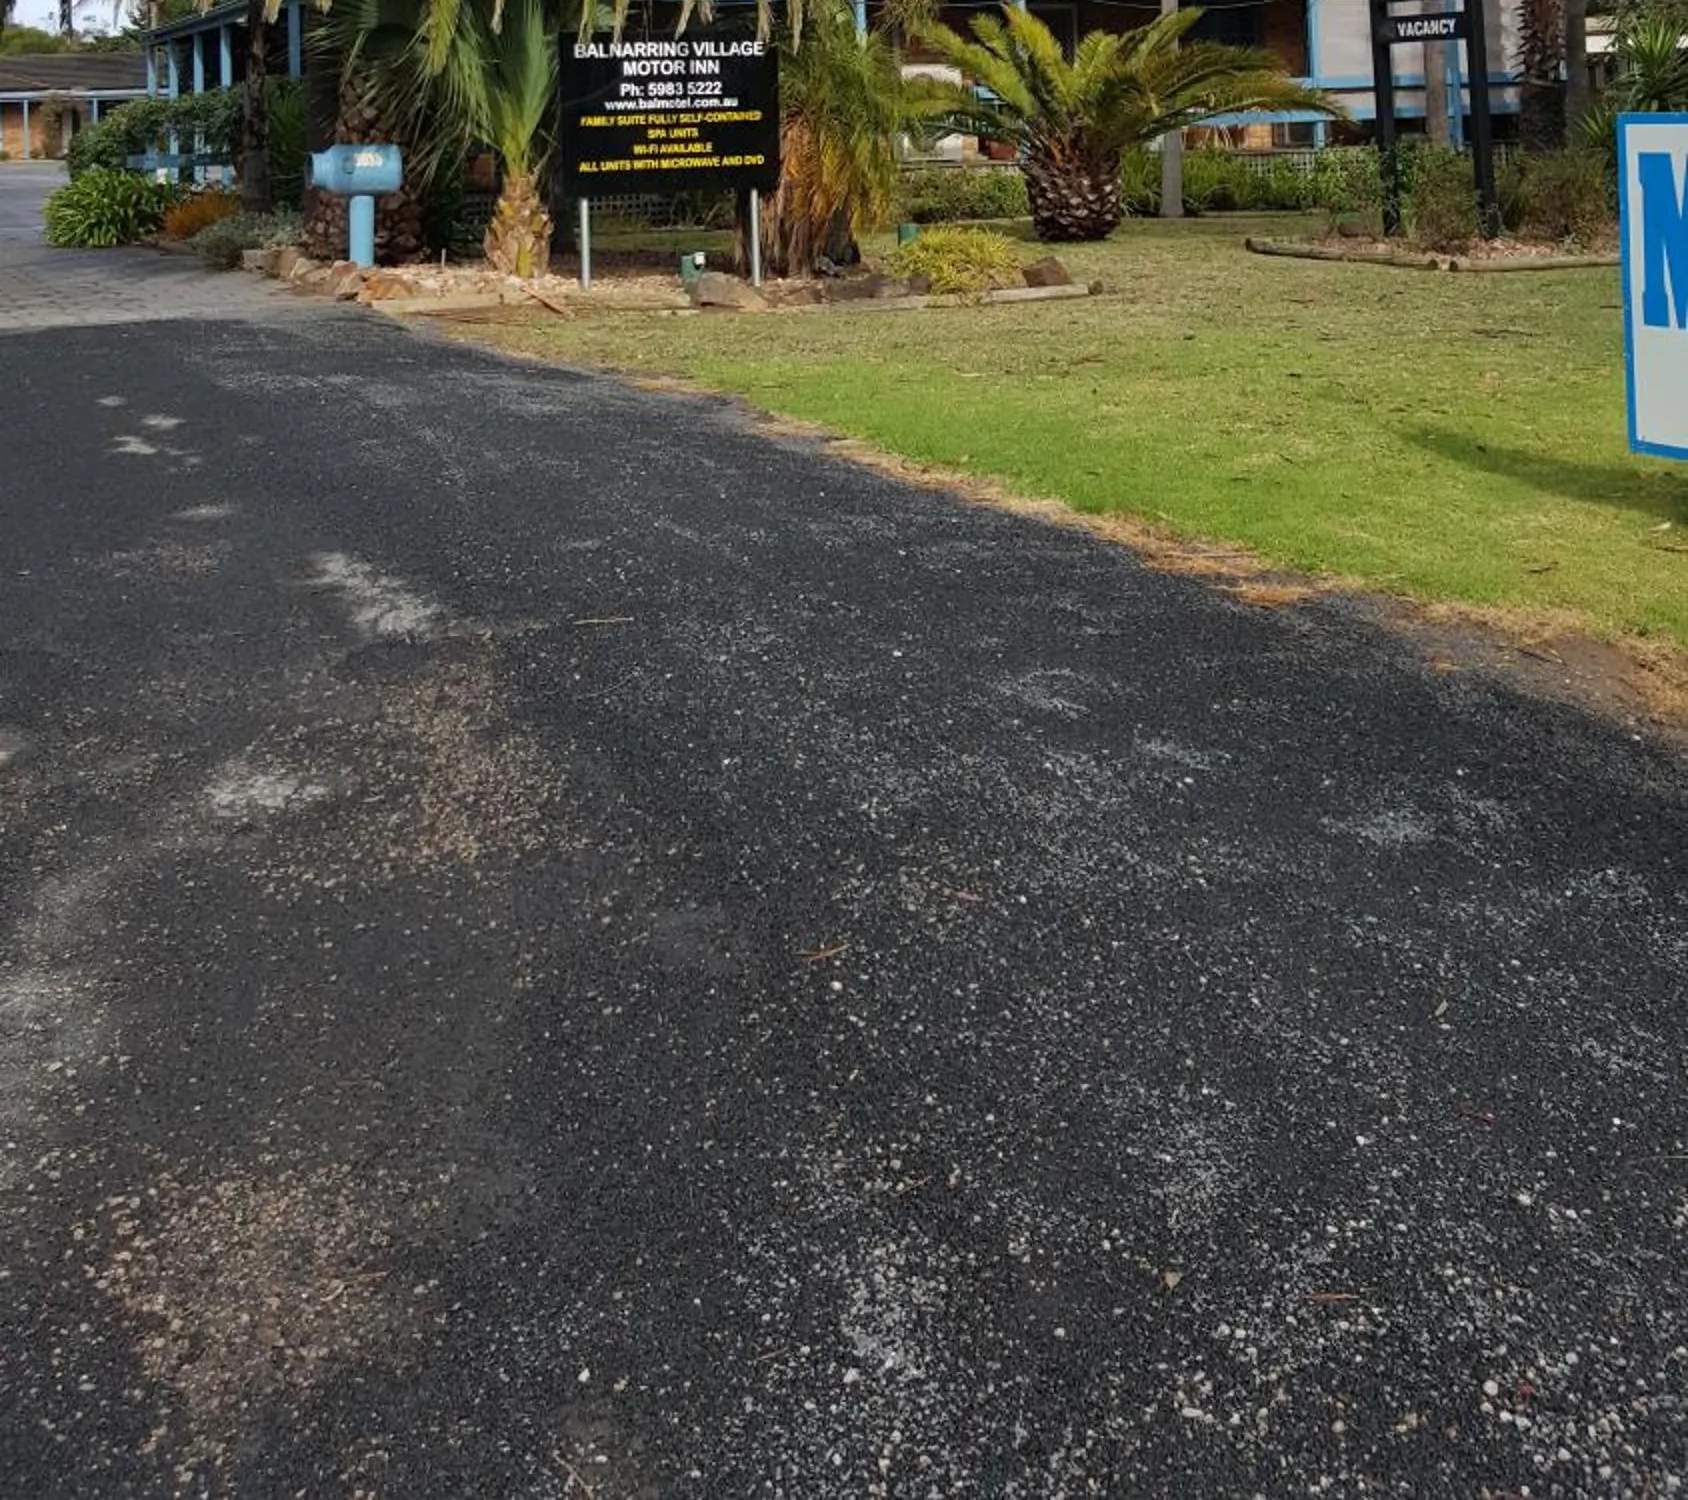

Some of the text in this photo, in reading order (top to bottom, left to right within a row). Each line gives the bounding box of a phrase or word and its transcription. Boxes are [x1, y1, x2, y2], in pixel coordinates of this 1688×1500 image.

[1397, 18, 1457, 38] VACANCY
[573, 40, 765, 59] BALNARRING VILLAGE
[623, 59, 720, 77] MOTOR INN
[620, 81, 723, 97] Ph: 5983 5222
[580, 114, 615, 127] FAMILY
[617, 113, 647, 126] SUITE
[648, 112, 678, 125] FULLY
[647, 127, 699, 139] SPA UNITS
[660, 141, 713, 154] AVAILABLE
[579, 161, 600, 173] ALL
[600, 160, 631, 172] UNITS
[660, 156, 720, 170] MICROWAVE
[721, 155, 743, 167] AND
[744, 153, 765, 166] DVD
